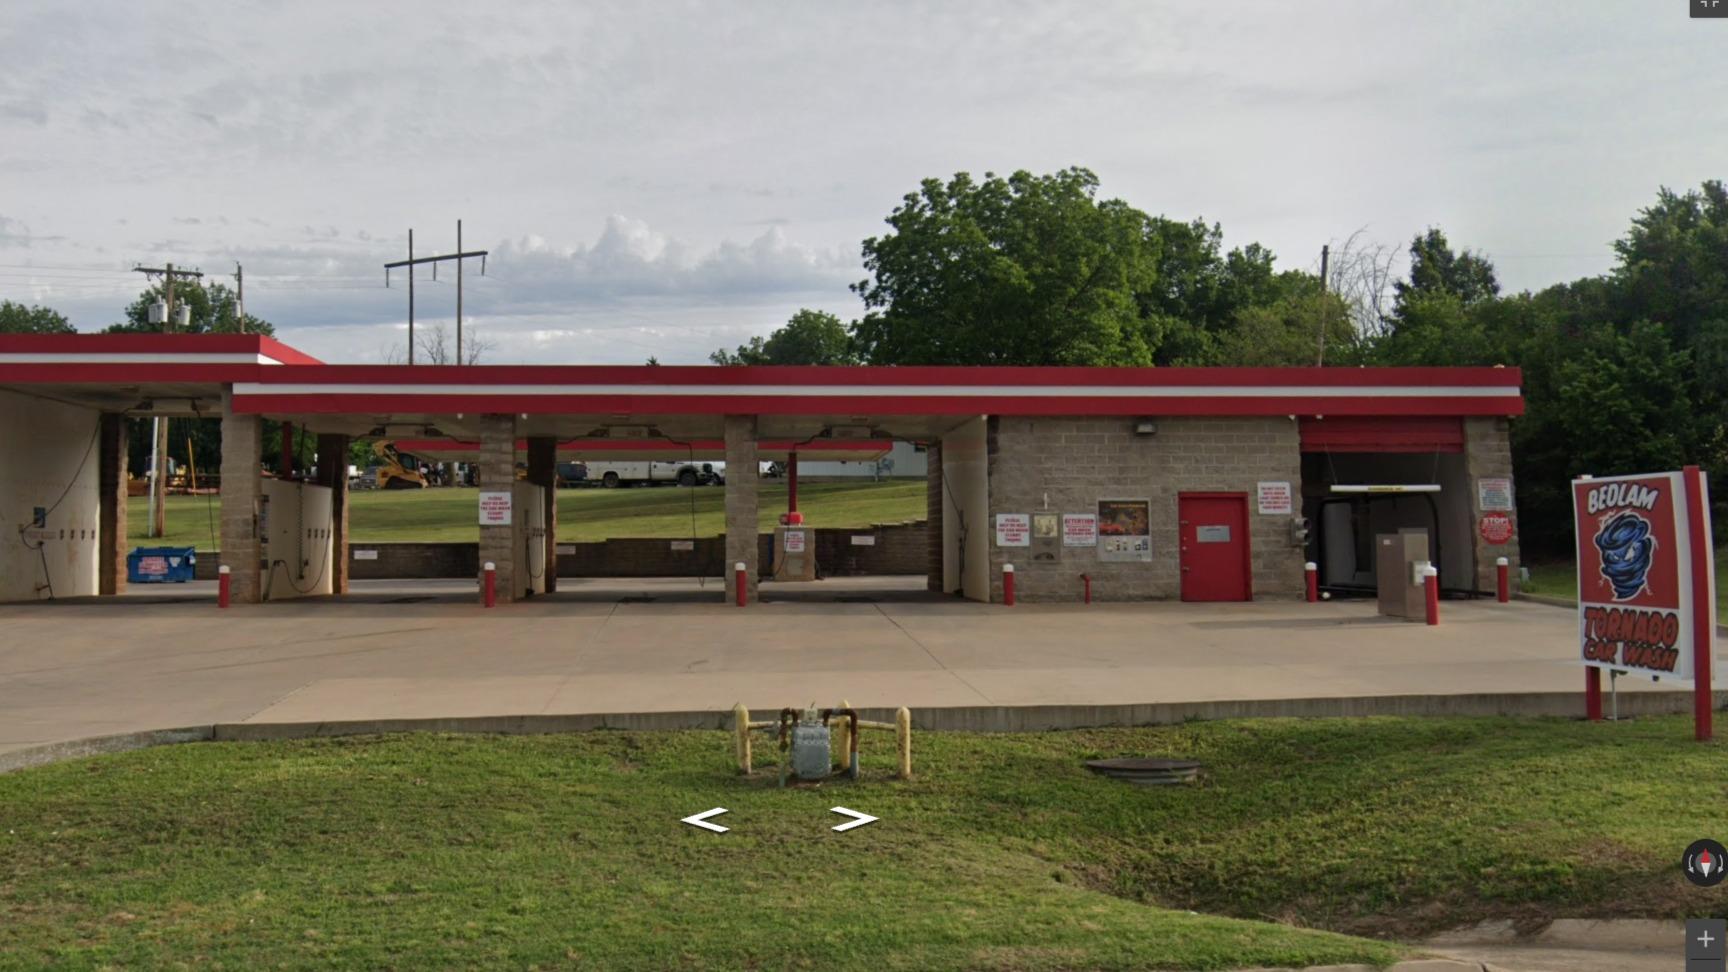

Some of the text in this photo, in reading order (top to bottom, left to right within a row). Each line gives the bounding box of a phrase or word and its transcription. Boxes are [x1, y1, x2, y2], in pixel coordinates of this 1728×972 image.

[1587, 483, 1658, 514] BEDLAM
[1584, 606, 1679, 648] TORNADO
[1583, 637, 1679, 673] CAR WASH
